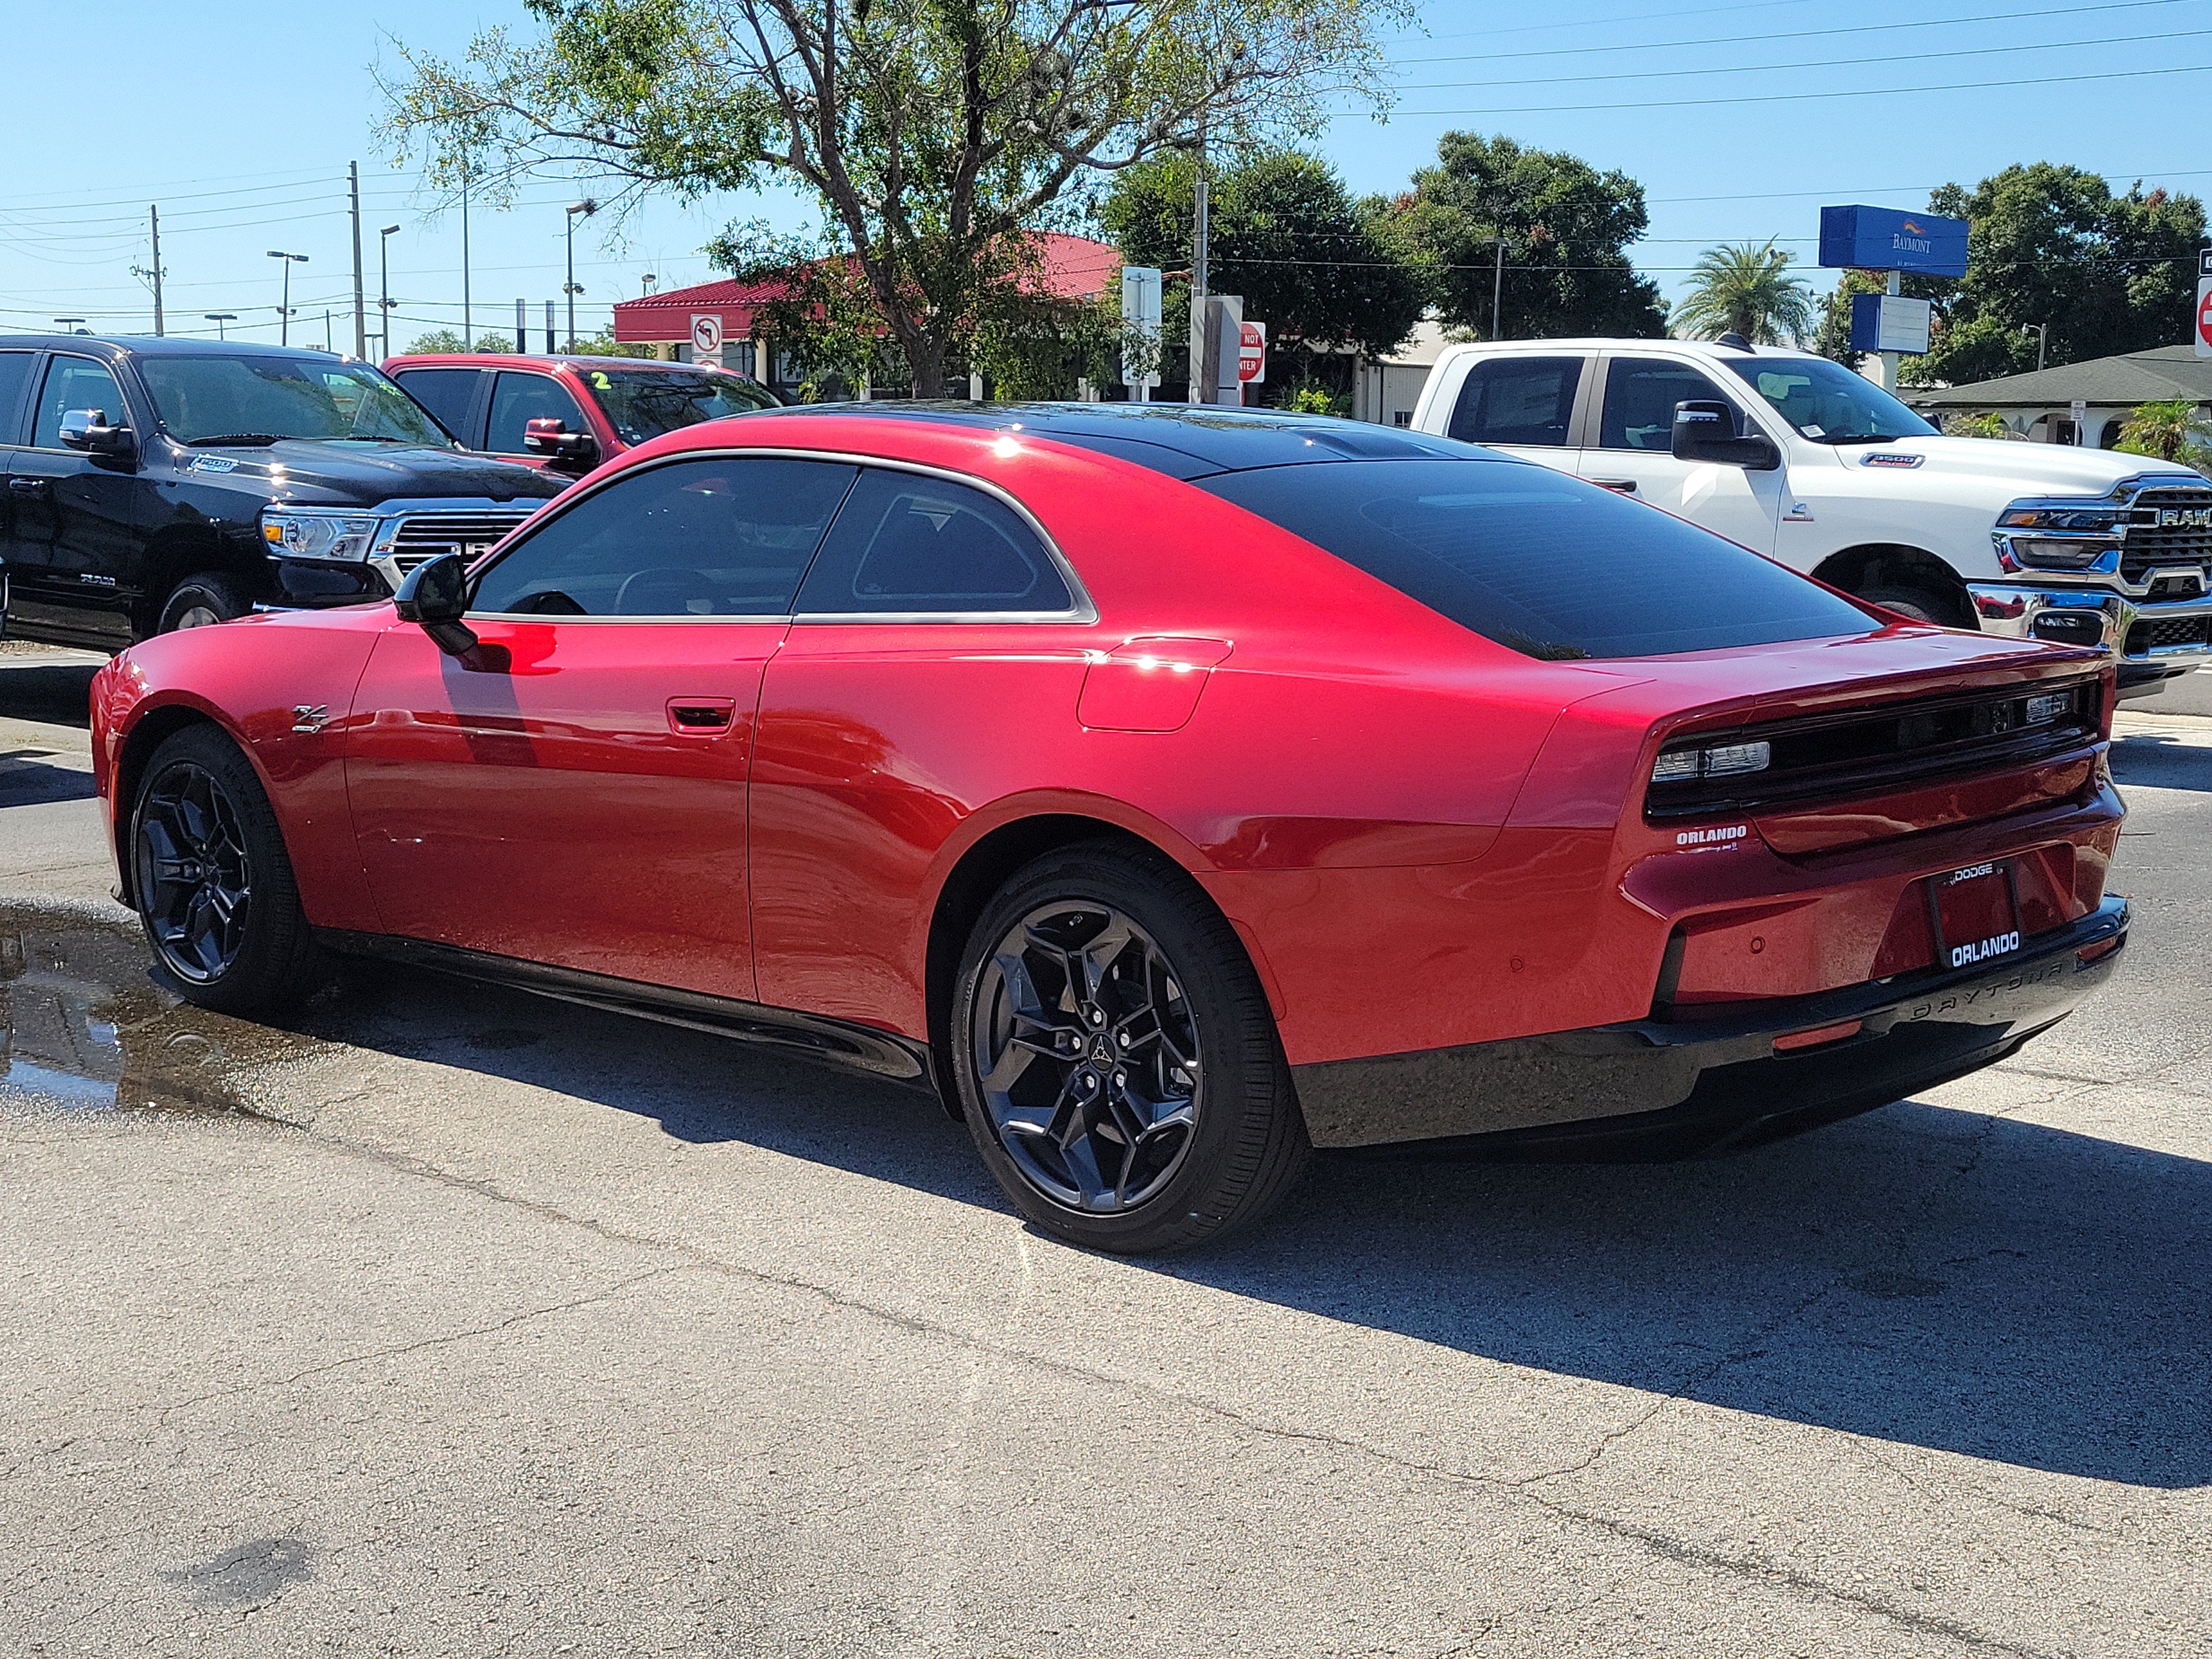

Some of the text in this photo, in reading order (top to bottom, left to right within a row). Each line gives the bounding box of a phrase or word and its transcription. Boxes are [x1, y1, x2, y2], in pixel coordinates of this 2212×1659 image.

[1893, 233, 1931, 254] BAYMONT
[1244, 335, 1259, 344] NOT
[1239, 360, 1256, 370] NTER
[2161, 510, 2209, 526] RAM
[1677, 825, 1747, 845] ORLANDO
[1955, 863, 1993, 882] DODGE
[1952, 931, 2019, 967] ORLANDO
[1910, 963, 2061, 1021] DAYTONA
